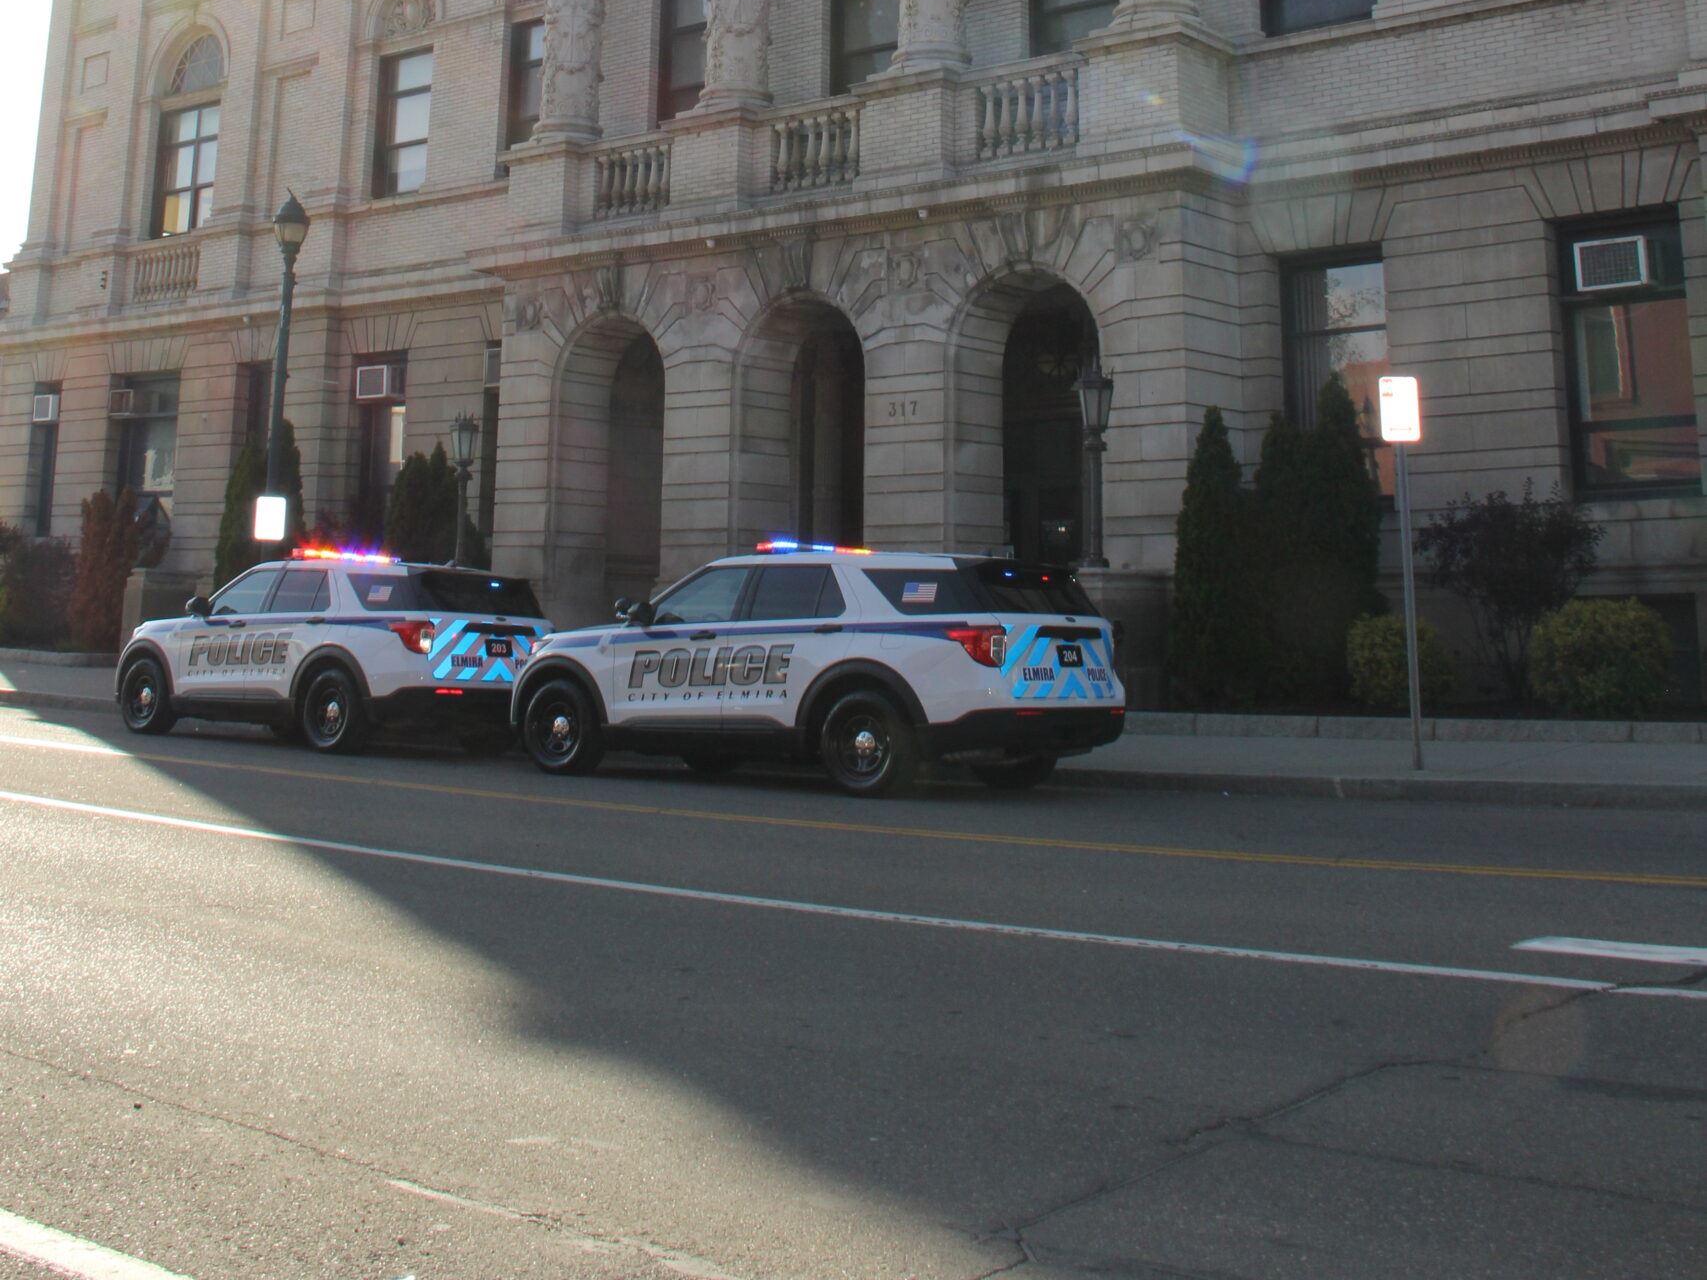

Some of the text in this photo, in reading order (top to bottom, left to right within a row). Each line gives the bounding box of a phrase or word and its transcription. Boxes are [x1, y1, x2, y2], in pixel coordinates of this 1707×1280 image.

[888, 400, 918, 417] 317
[188, 631, 294, 667] POLICE
[490, 642, 507, 654] 203
[451, 654, 483, 668] ELMIRA
[1062, 650, 1078, 662] 204
[627, 643, 795, 689] POLICE
[1022, 667, 1107, 682] ELMIRA POLICE
[627, 689, 788, 702] CITY OF ELMIRA
